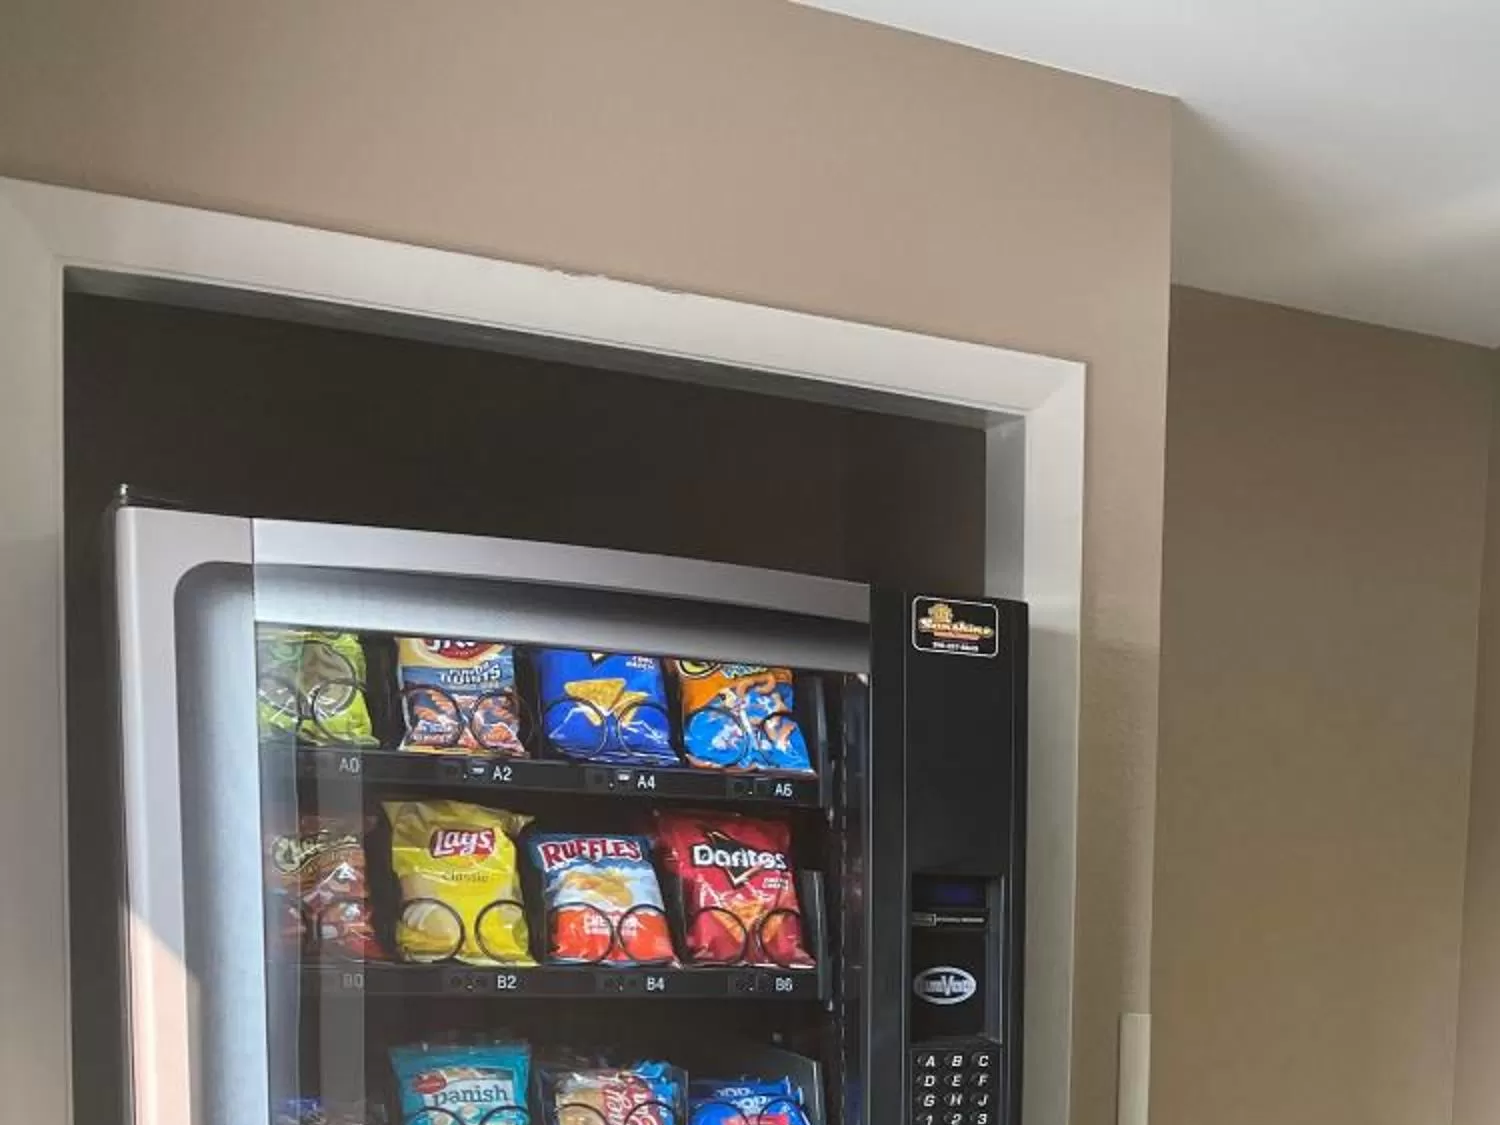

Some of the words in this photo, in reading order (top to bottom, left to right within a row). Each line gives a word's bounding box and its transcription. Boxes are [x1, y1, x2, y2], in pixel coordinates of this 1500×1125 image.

[493, 767, 513, 781] A2
[637, 774, 656, 789] A4
[774, 783, 793, 797] A6
[538, 838, 642, 870] RUFFLES
[692, 844, 787, 869] Doritos
[497, 974, 518, 989] B2
[646, 977, 665, 991] B4
[925, 1055, 935, 1067] A
[951, 1055, 963, 1067] B
[978, 1055, 989, 1067] C
[923, 1075, 935, 1087] D
[951, 1074, 962, 1087] E
[977, 1074, 989, 1087] F
[923, 1094, 935, 1107] G
[977, 1094, 989, 1107] J
[951, 1113, 962, 1125] 2
[977, 1113, 987, 1125] 3
